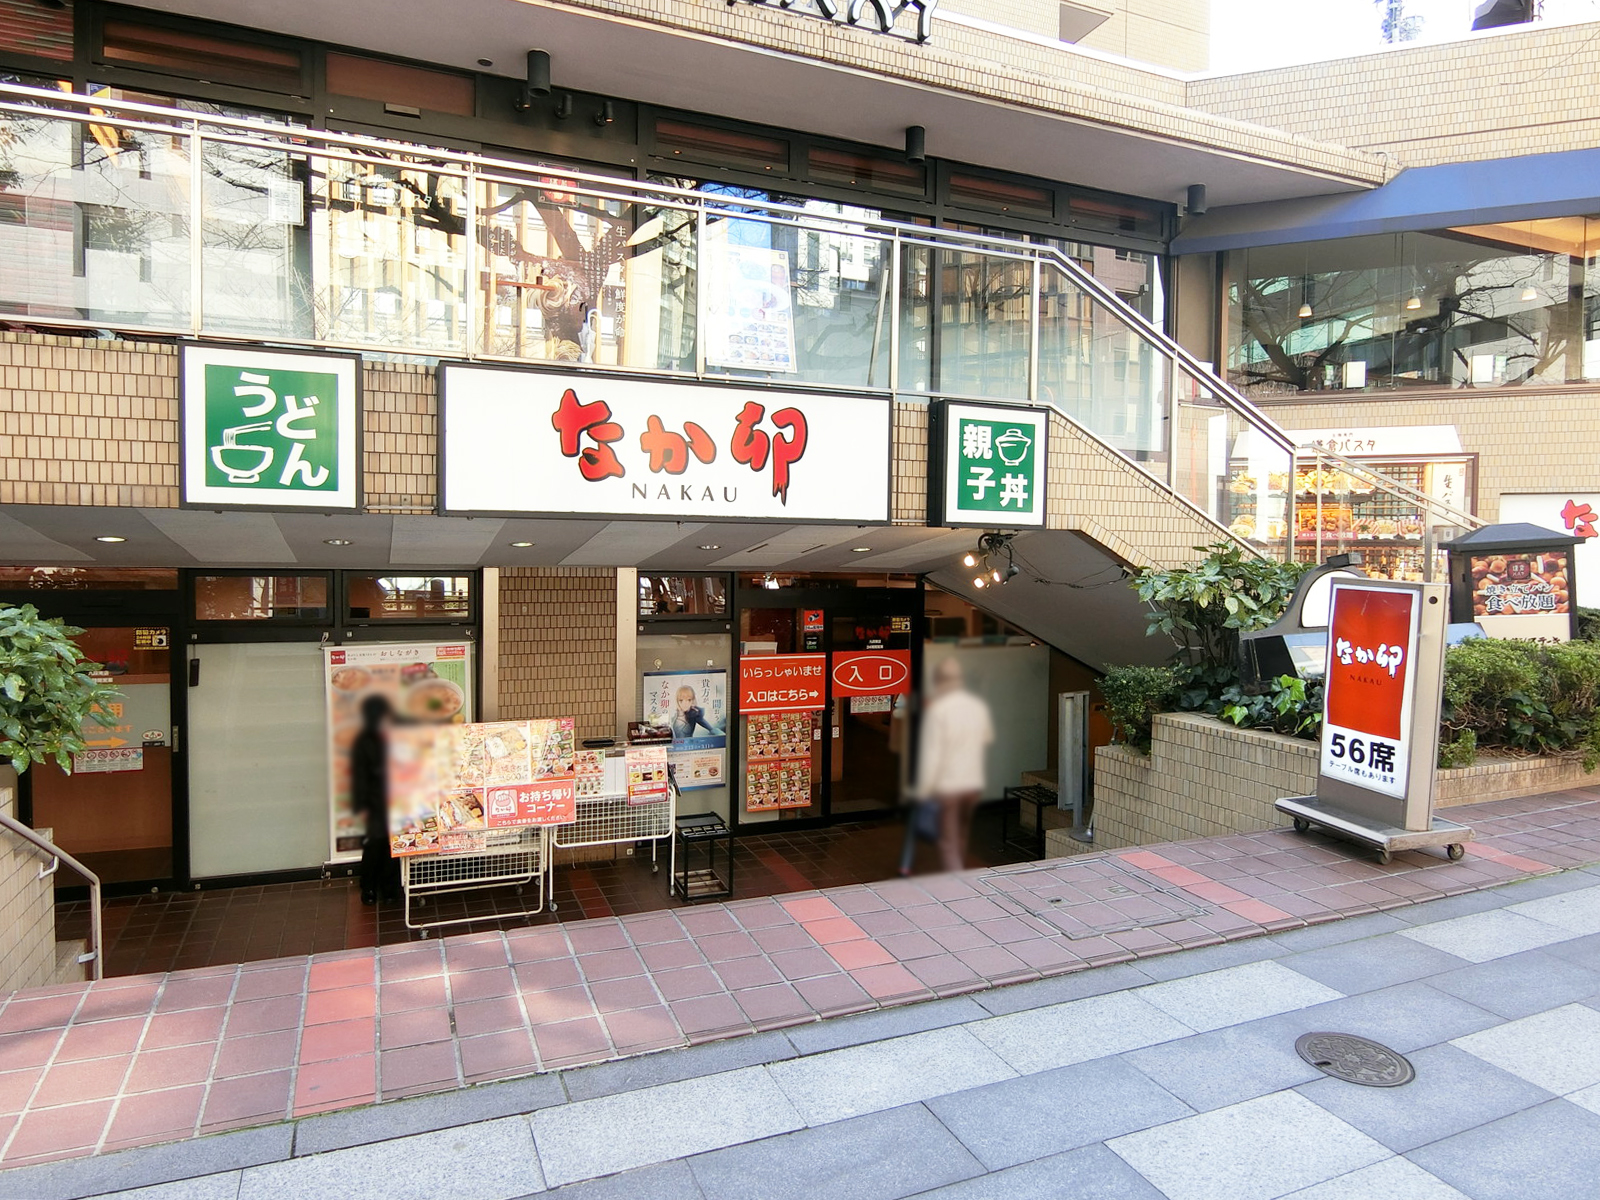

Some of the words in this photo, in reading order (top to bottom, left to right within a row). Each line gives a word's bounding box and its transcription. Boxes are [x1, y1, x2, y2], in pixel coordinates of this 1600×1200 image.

[551, 388, 808, 507] なか卯
[962, 423, 1029, 508] 親子丼
[631, 482, 738, 503] NAKAU
[1484, 593, 1557, 612] 食べ放題
[1335, 636, 1403, 678] なか卯
[743, 665, 822, 678] いらっしゃいませ
[848, 665, 892, 682] 入口
[1349, 673, 1383, 686] NAKAU
[746, 689, 809, 703] 入口はこちら
[1330, 732, 1396, 773] 56席
[519, 787, 572, 803] お持ち帰り
[526, 801, 566, 813] コーナー
